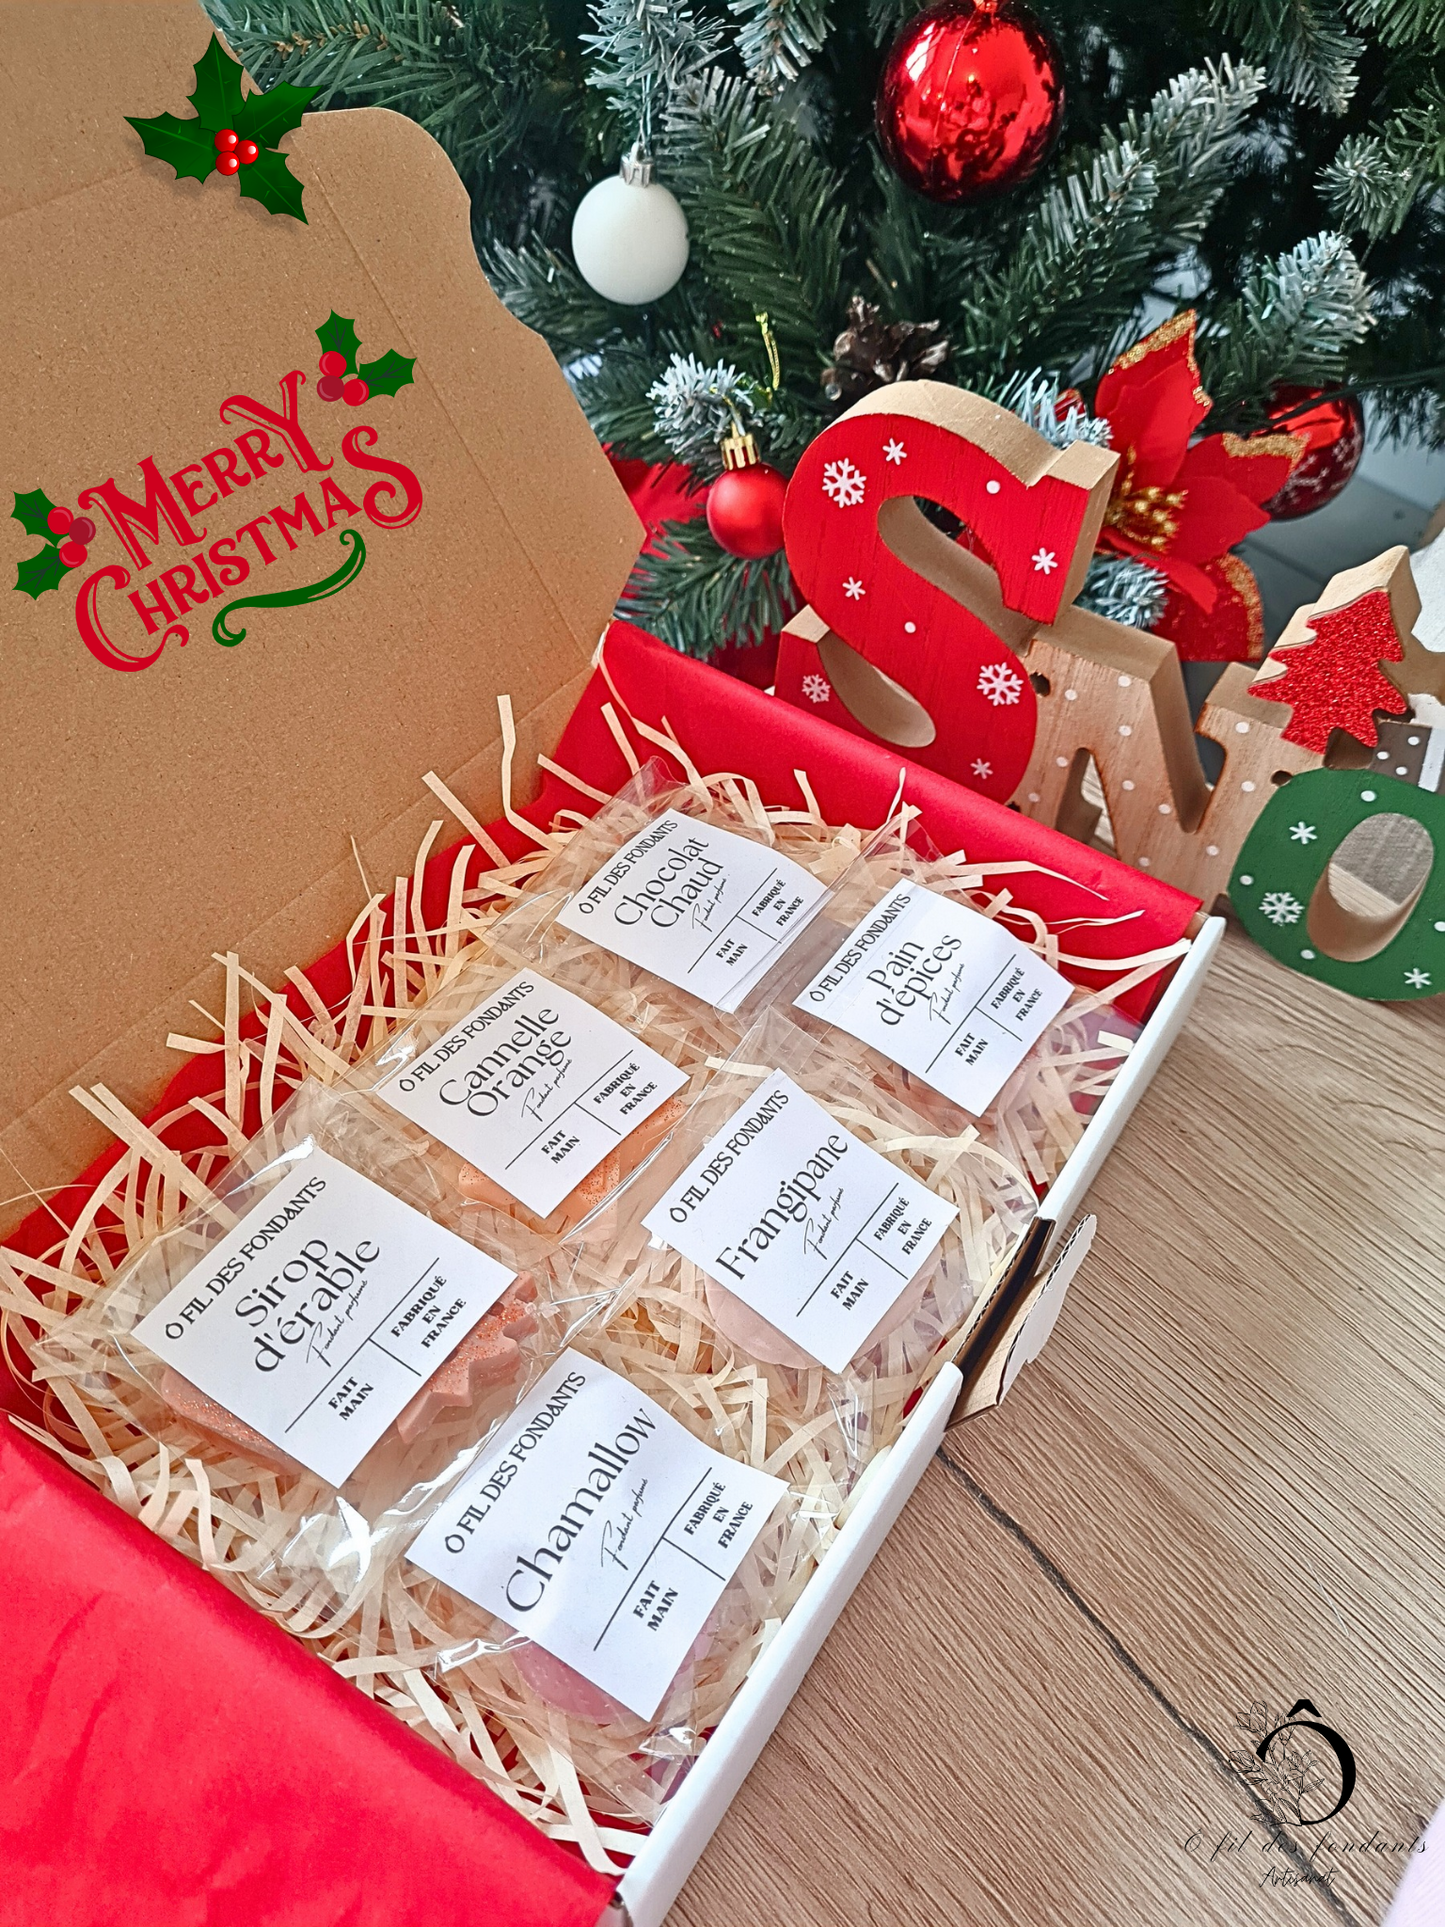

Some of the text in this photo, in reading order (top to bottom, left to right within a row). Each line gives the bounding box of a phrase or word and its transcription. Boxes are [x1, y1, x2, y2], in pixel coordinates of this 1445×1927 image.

[587, 886, 612, 904] FIL
[603, 862, 631, 886] DES
[614, 838, 709, 925] Chocolat
[651, 857, 723, 927] Chaud
[752, 879, 786, 916] FABRIQUÉ
[772, 899, 788, 911] EN
[776, 897, 803, 926] FRANCE
[716, 939, 734, 958] FAIT
[726, 945, 748, 967] MAIN
[867, 942, 924, 989] Pain
[818, 975, 843, 992] FIL
[834, 949, 862, 974] DES
[876, 935, 961, 1025] d'épices
[991, 968, 1024, 1009] FABRIQUÉ
[1013, 991, 1025, 1002] EN
[1015, 989, 1041, 1021] FRANCE
[411, 1062, 441, 1082] FIL
[433, 1035, 467, 1062] DES
[439, 1009, 559, 1105] Cannelle
[955, 1033, 975, 1056] FAIT
[965, 1039, 988, 1065] MAIN
[467, 1031, 571, 1116] Orange
[593, 1063, 640, 1104] FABRIQUÉ
[620, 1083, 636, 1097] EN
[521, 1083, 553, 1122] Fondant
[620, 1082, 657, 1115] FRANCE
[541, 1130, 566, 1154] FAIT
[551, 1136, 580, 1164] MAIN
[680, 1185, 710, 1210] FIL
[700, 1152, 733, 1186] DES
[716, 1135, 848, 1280] Frangipane
[874, 1197, 909, 1241] FABRIQUÉ
[897, 1220, 911, 1235] EN
[804, 1214, 832, 1260] Fondant
[902, 1218, 932, 1255] FRANCE
[179, 1297, 214, 1324] FIL
[205, 1257, 245, 1296] DES
[235, 1240, 329, 1327] Sirop
[831, 1271, 853, 1299] FAIT
[842, 1278, 869, 1310] MAIN
[254, 1241, 379, 1372] d'érable
[391, 1276, 447, 1337] FABRIQUÉ
[421, 1299, 466, 1348] FRANCE
[422, 1305, 441, 1324] EN
[306, 1315, 345, 1368] Fondant
[328, 1377, 357, 1409] FAIT
[339, 1383, 374, 1420] MAIN
[457, 1505, 491, 1534] FIL
[480, 1461, 517, 1502] DES
[506, 1408, 656, 1611] Chamallow
[684, 1483, 725, 1535] FABRIQUÉ
[713, 1507, 729, 1524] EN
[601, 1513, 633, 1571] Fondant
[718, 1502, 753, 1548] FRANCE
[633, 1580, 660, 1618] FAIT
[647, 1588, 678, 1631] MAIN
